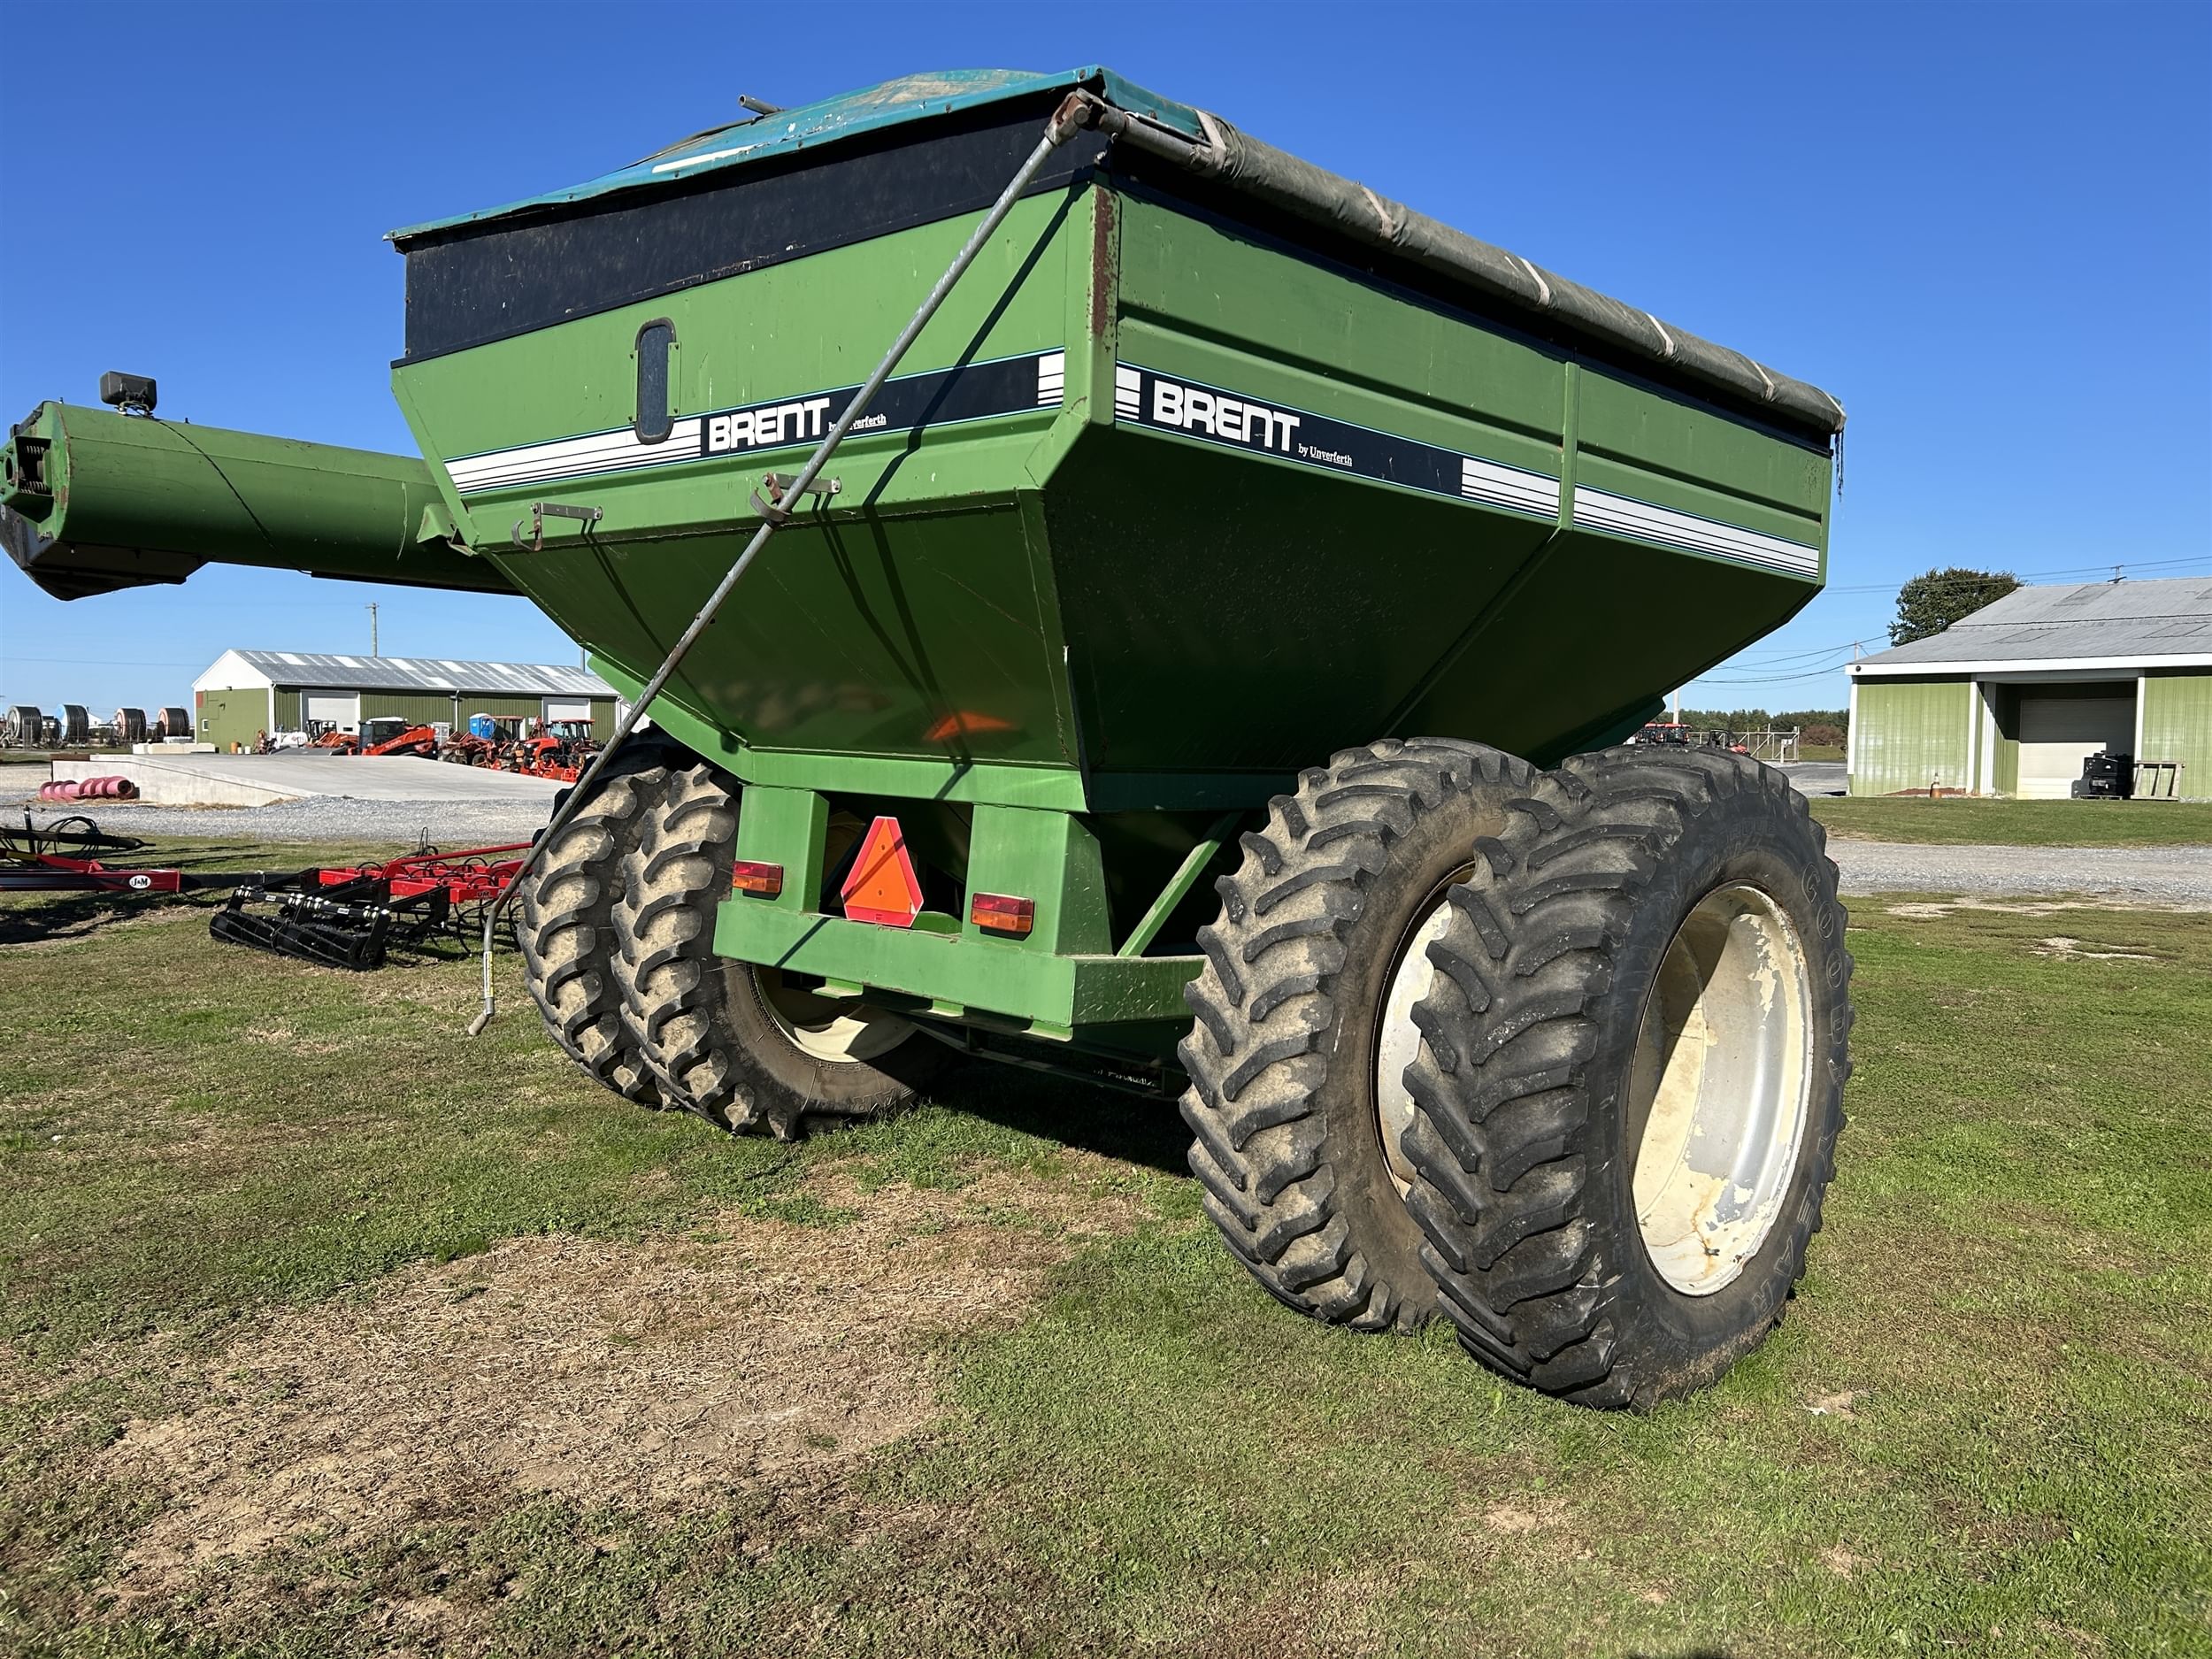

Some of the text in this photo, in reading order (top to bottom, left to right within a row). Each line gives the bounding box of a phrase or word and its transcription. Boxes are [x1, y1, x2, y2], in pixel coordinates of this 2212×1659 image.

[709, 397, 830, 452] BRENT
[849, 413, 887, 431] verferth
[1153, 380, 1352, 467] BRENT by Unverferth
